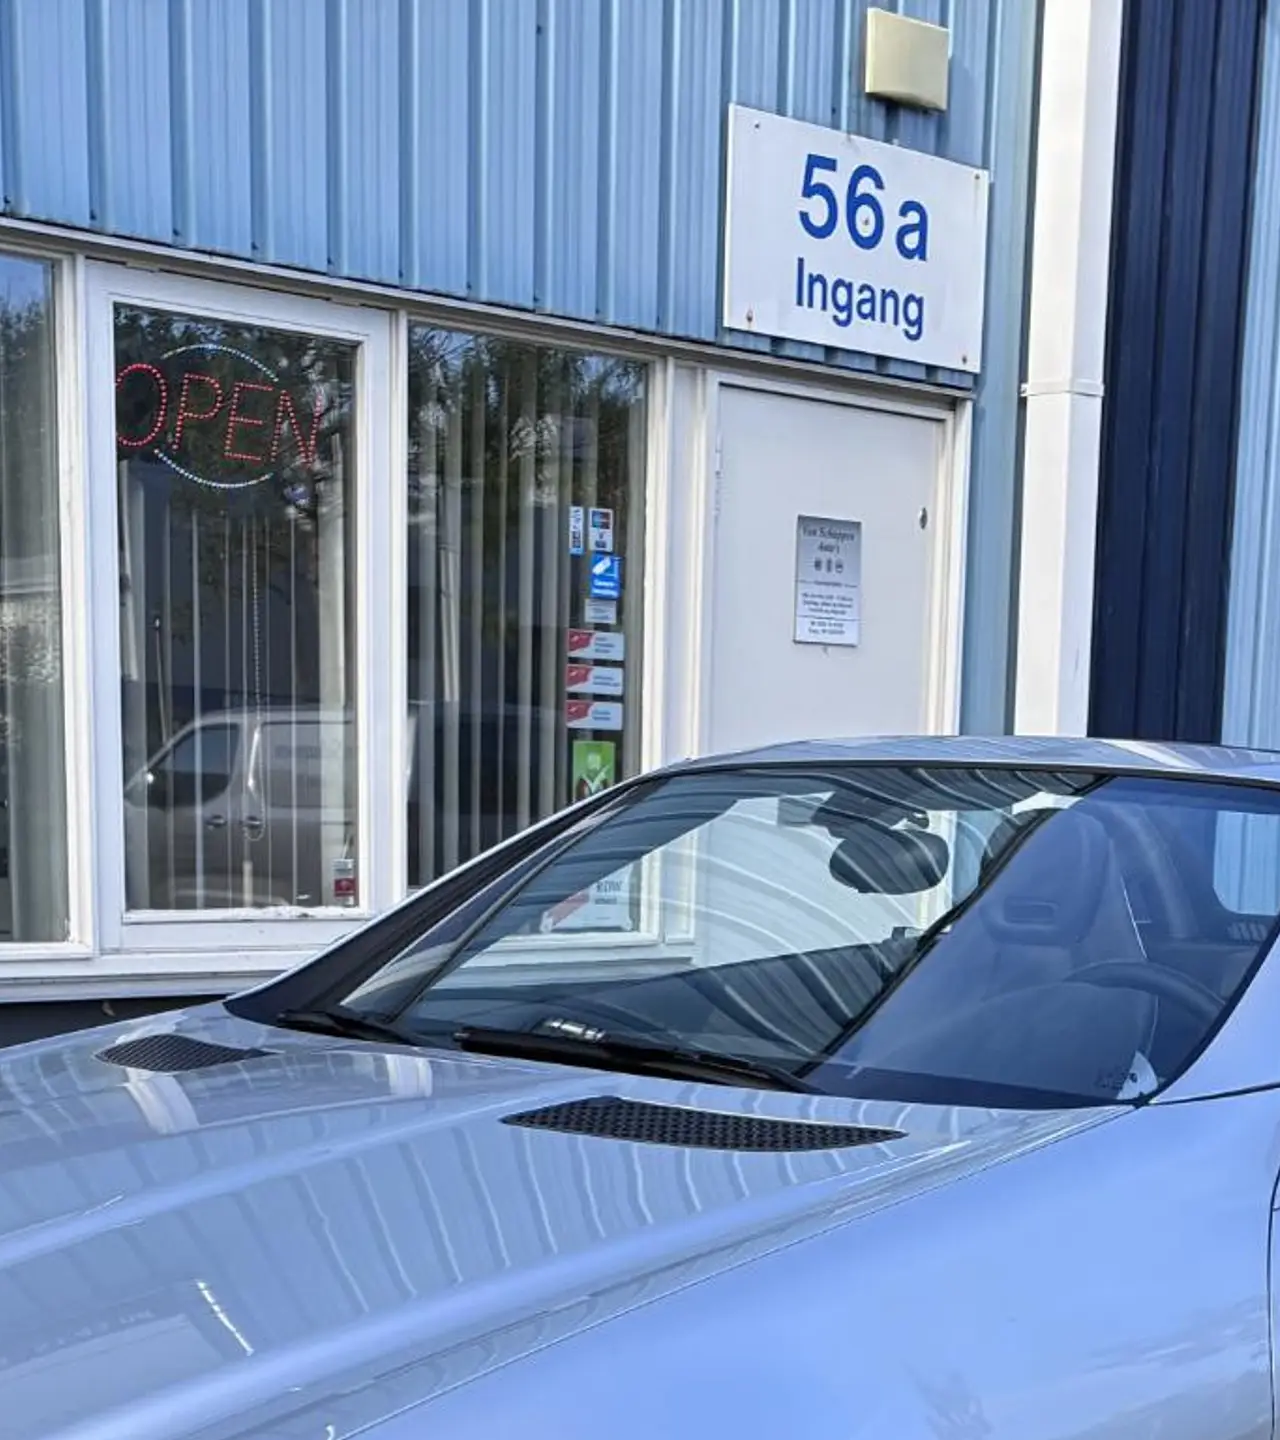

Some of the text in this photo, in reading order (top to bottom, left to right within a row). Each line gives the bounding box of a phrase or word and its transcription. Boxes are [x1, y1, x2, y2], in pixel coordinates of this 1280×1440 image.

[799, 153, 930, 262] 56a
[795, 257, 925, 341] Ingang
[116, 363, 324, 469] OPEN
